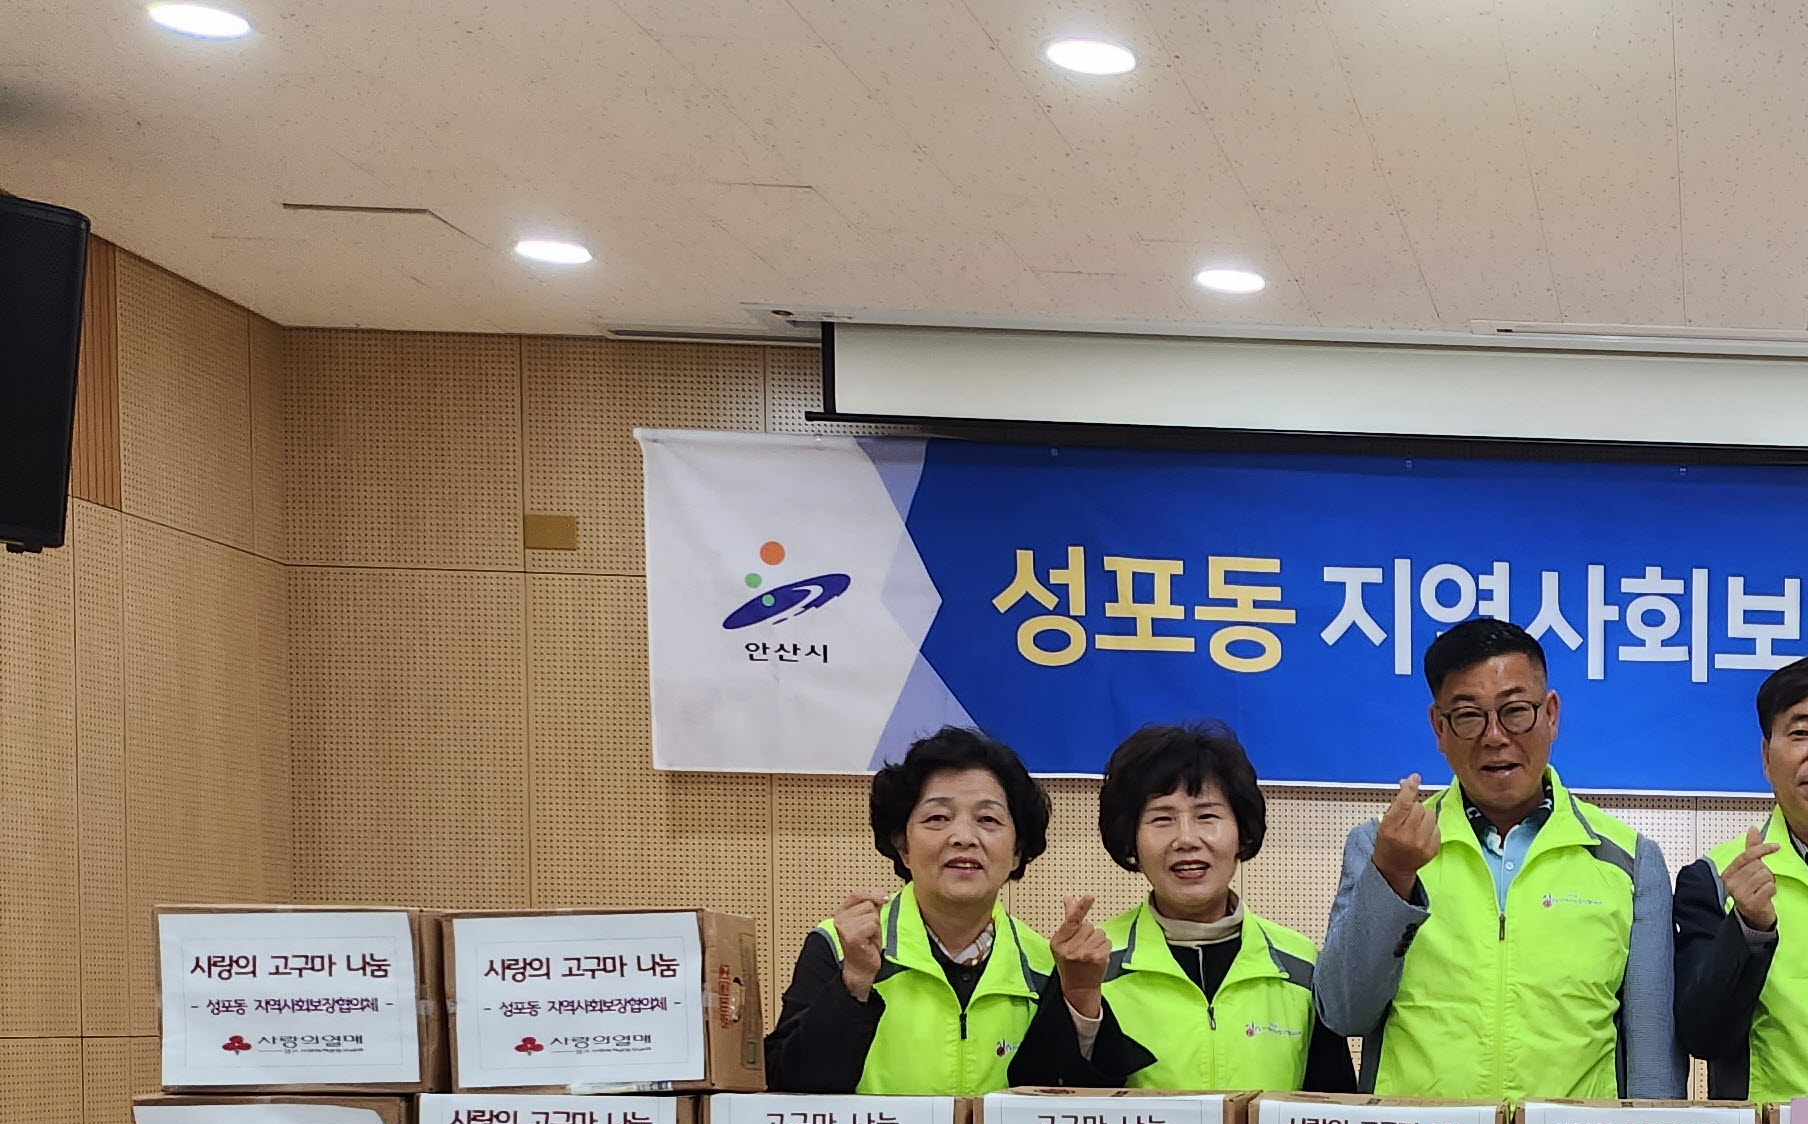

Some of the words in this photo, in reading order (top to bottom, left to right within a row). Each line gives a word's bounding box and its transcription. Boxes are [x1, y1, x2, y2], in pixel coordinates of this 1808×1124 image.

[993, 544, 1297, 674] 성포동
[745, 642, 829, 664] 안산시
[189, 954, 258, 981] 사랑의
[267, 953, 338, 979] 고구마
[345, 952, 392, 979] 나눔
[483, 956, 551, 984] 사랑의
[560, 954, 629, 980] 고구마
[636, 952, 681, 979] 나눔
[205, 998, 249, 1016] 성포동
[253, 996, 380, 1015] 지역사회보장협의체
[258, 1035, 363, 1049] 사랑의열매
